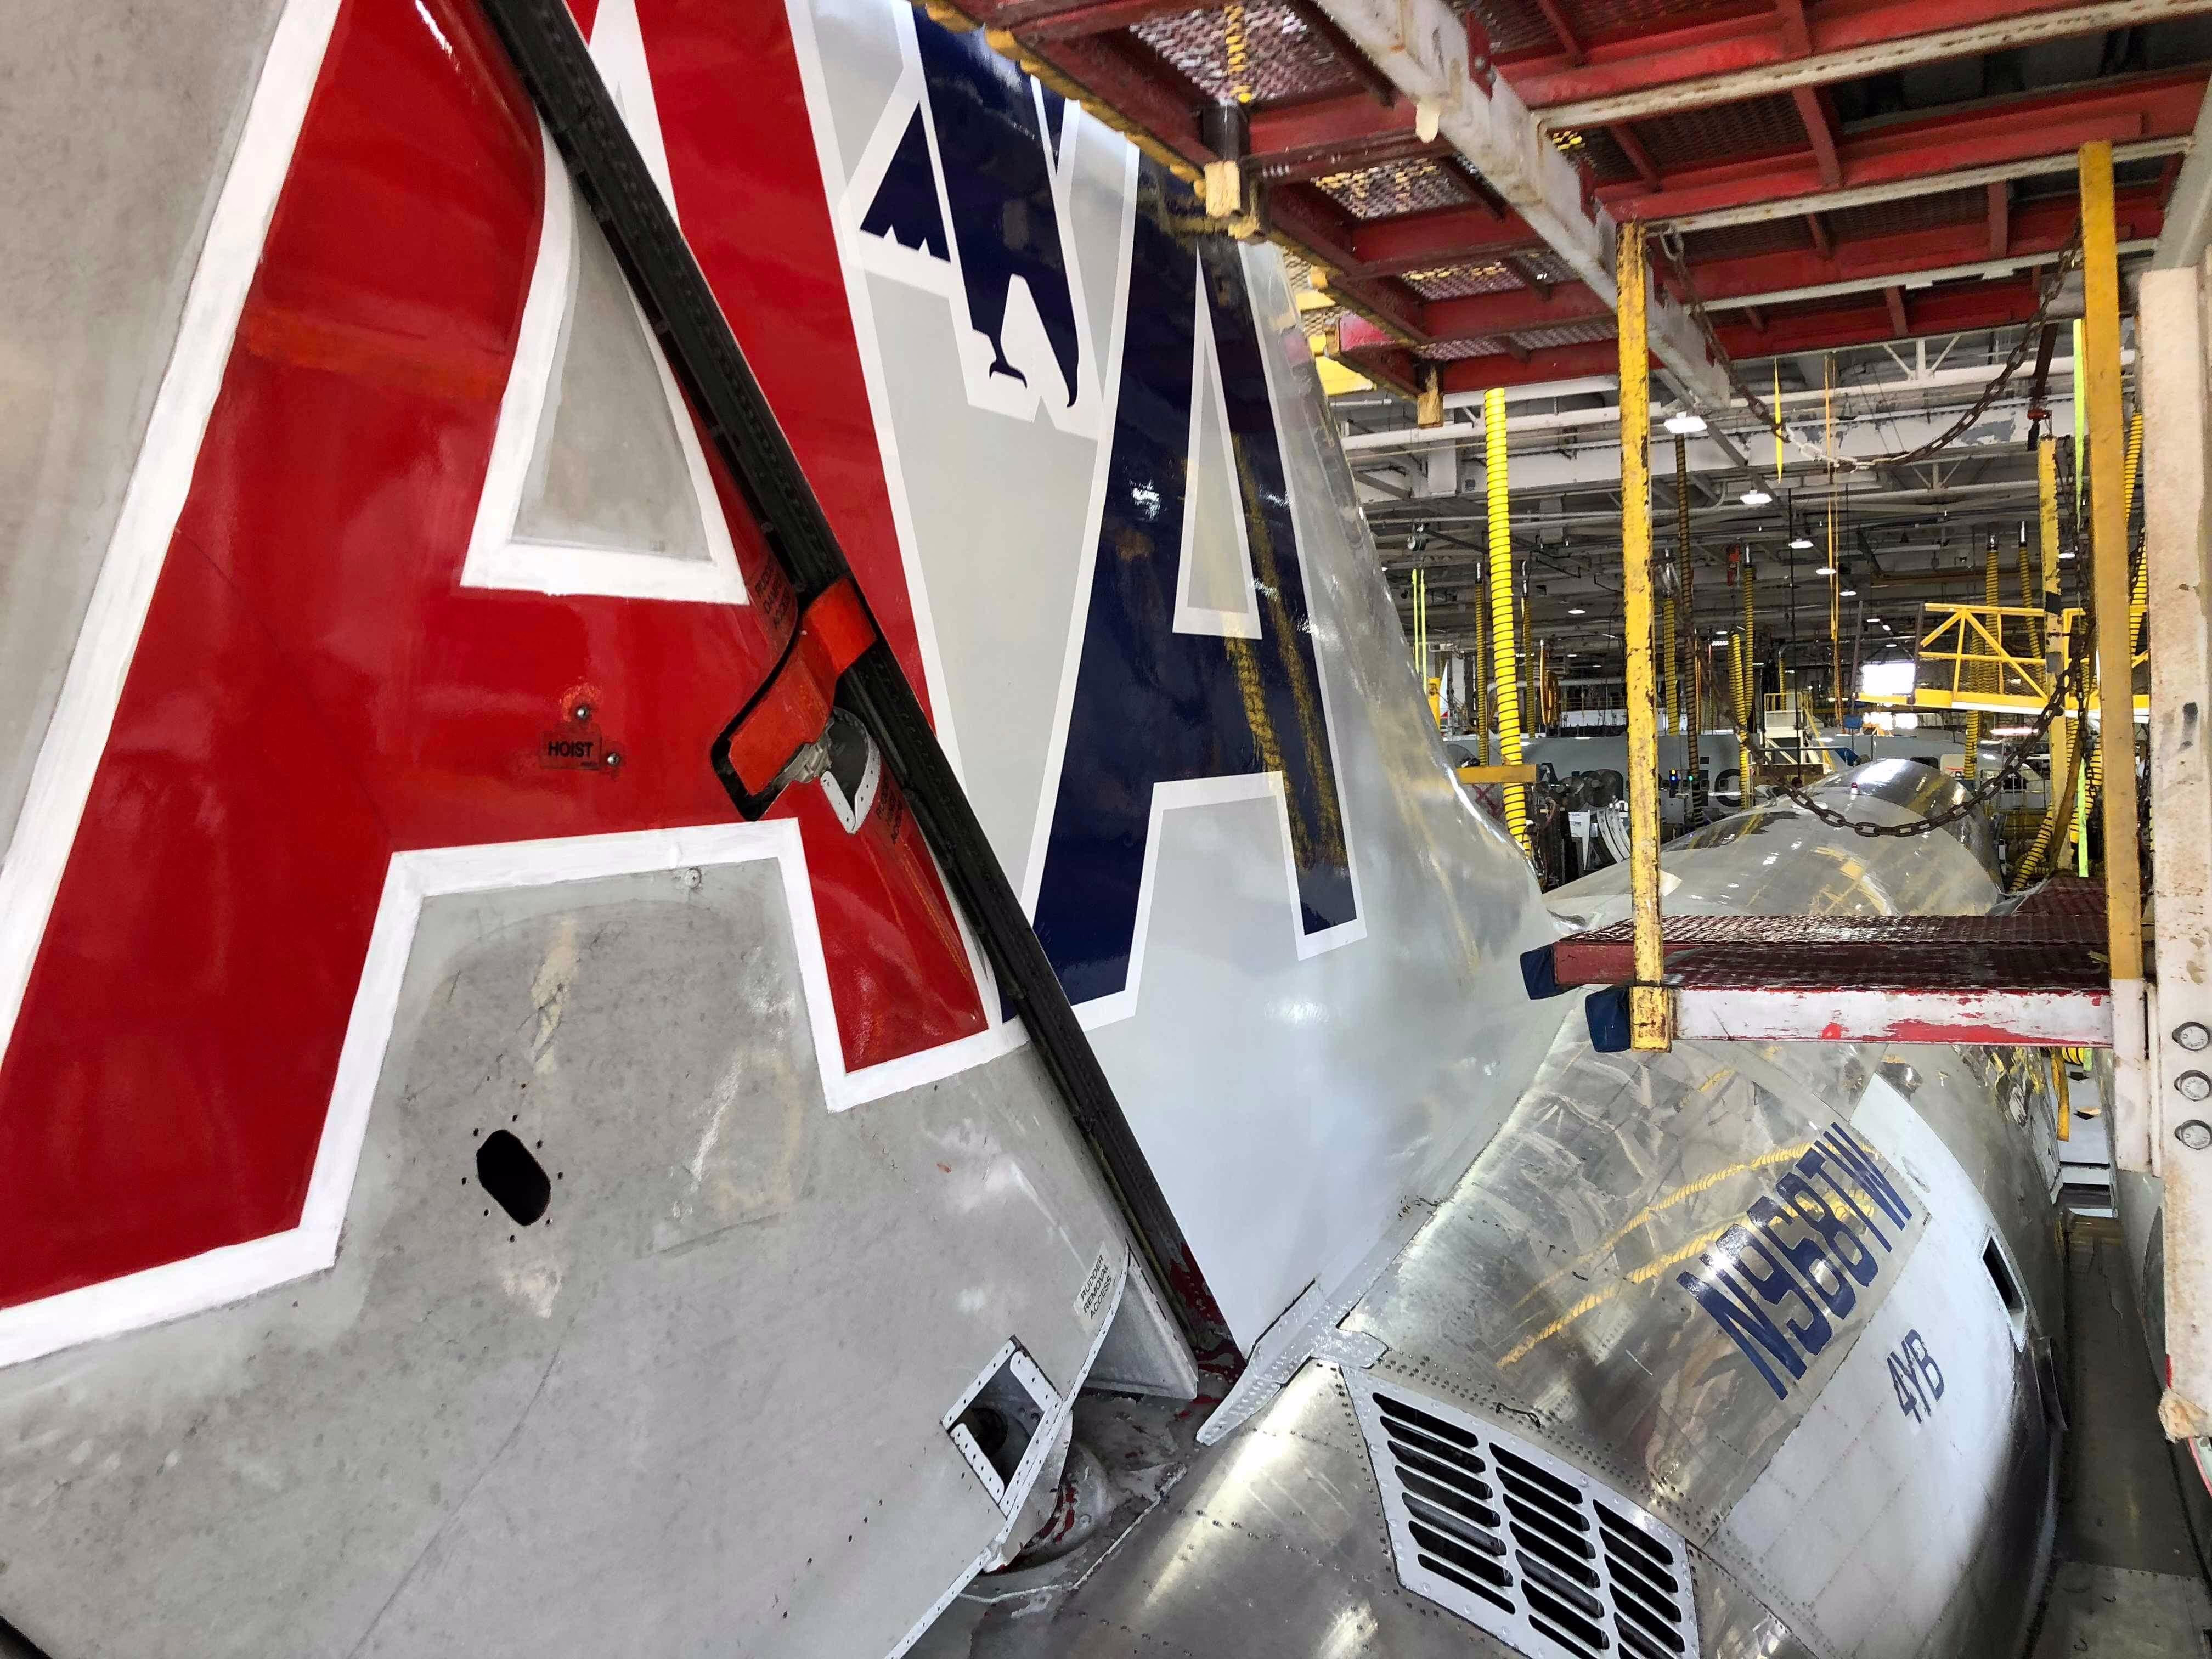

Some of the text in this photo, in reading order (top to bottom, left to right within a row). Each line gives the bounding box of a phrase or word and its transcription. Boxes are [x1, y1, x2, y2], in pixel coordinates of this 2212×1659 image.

[548, 740, 594, 757] HOIST
[1081, 1254, 1104, 1301] RUDDER
[1675, 1121, 1912, 1401] N968TW
[1083, 1264, 1109, 1313] REMOVAL
[1090, 1274, 1111, 1319] ACCESS
[1887, 1328, 1945, 1424] 4YB
